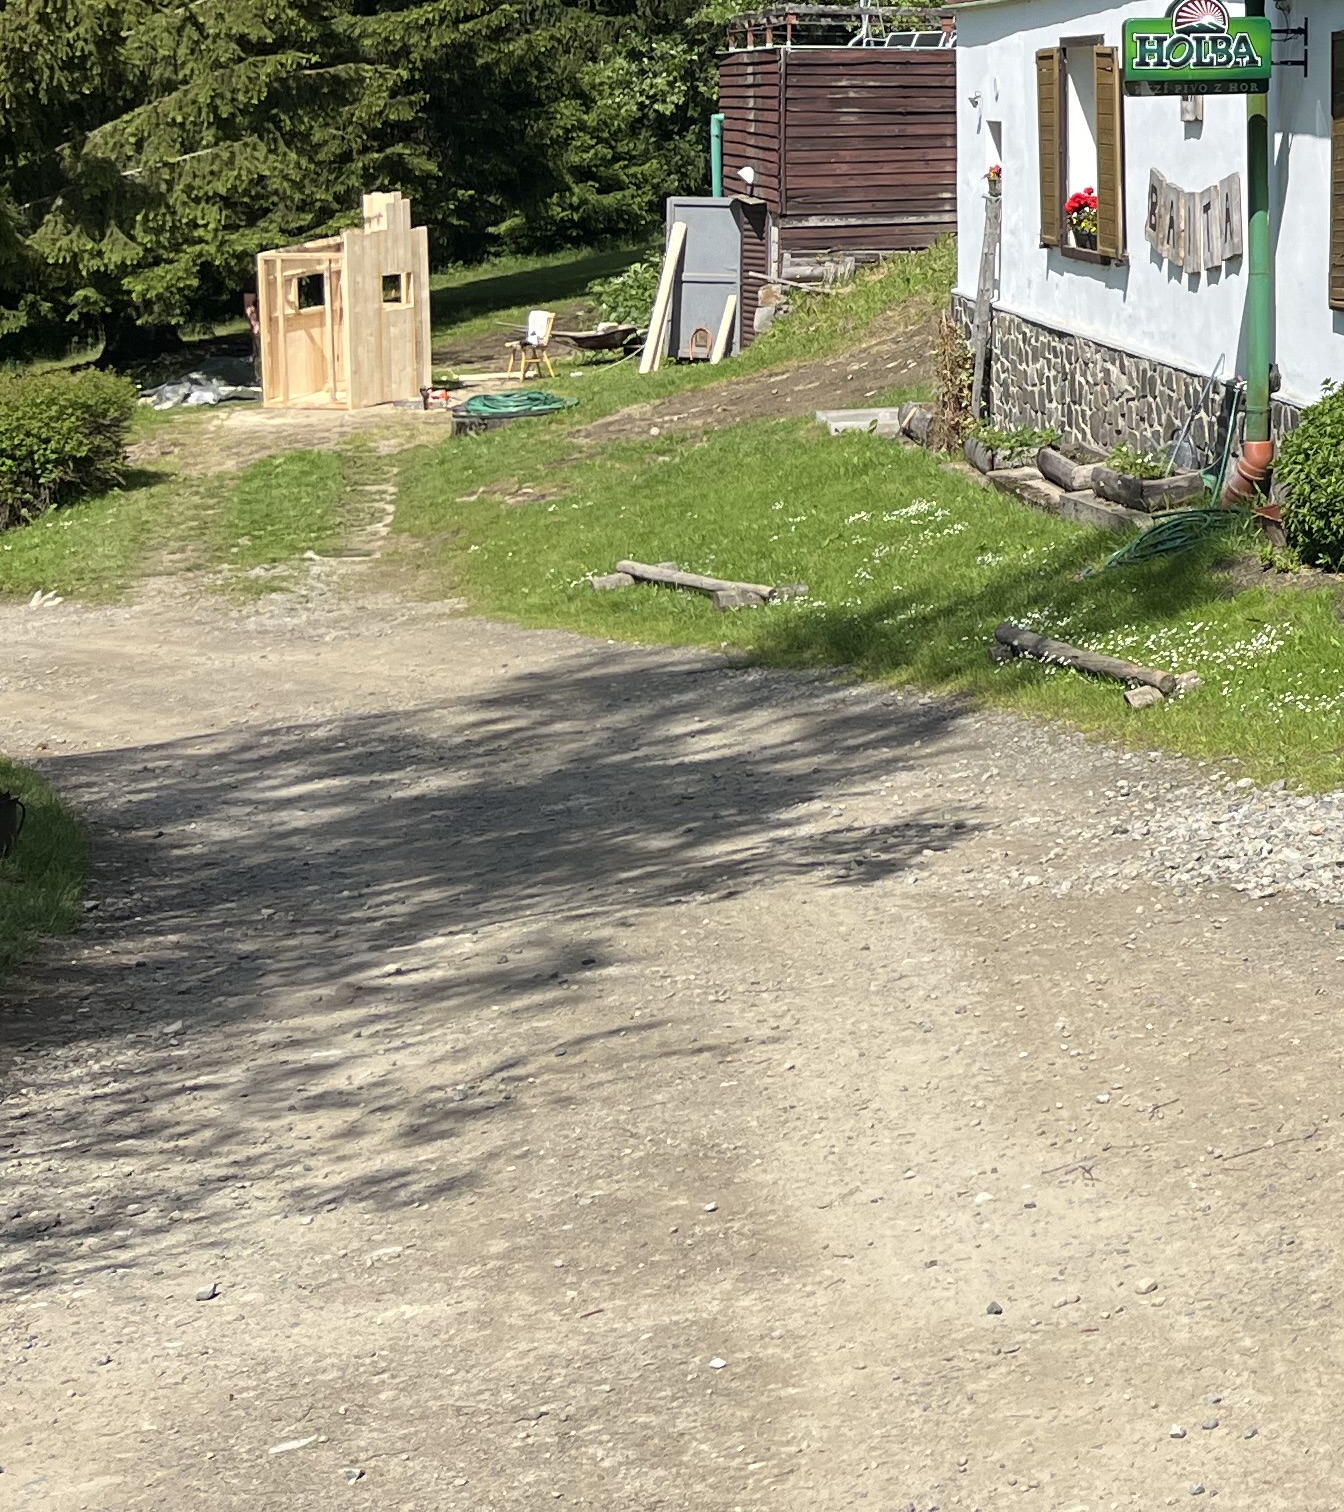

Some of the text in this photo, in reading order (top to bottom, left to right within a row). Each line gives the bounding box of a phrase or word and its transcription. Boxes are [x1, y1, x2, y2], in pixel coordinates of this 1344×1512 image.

[1133, 33, 1261, 69] HOLBA
[1174, 83, 1208, 94] PIVO
[1213, 83, 1224, 93] Z
[1228, 82, 1259, 92] HOR
[1149, 183, 1234, 256] BAITA
